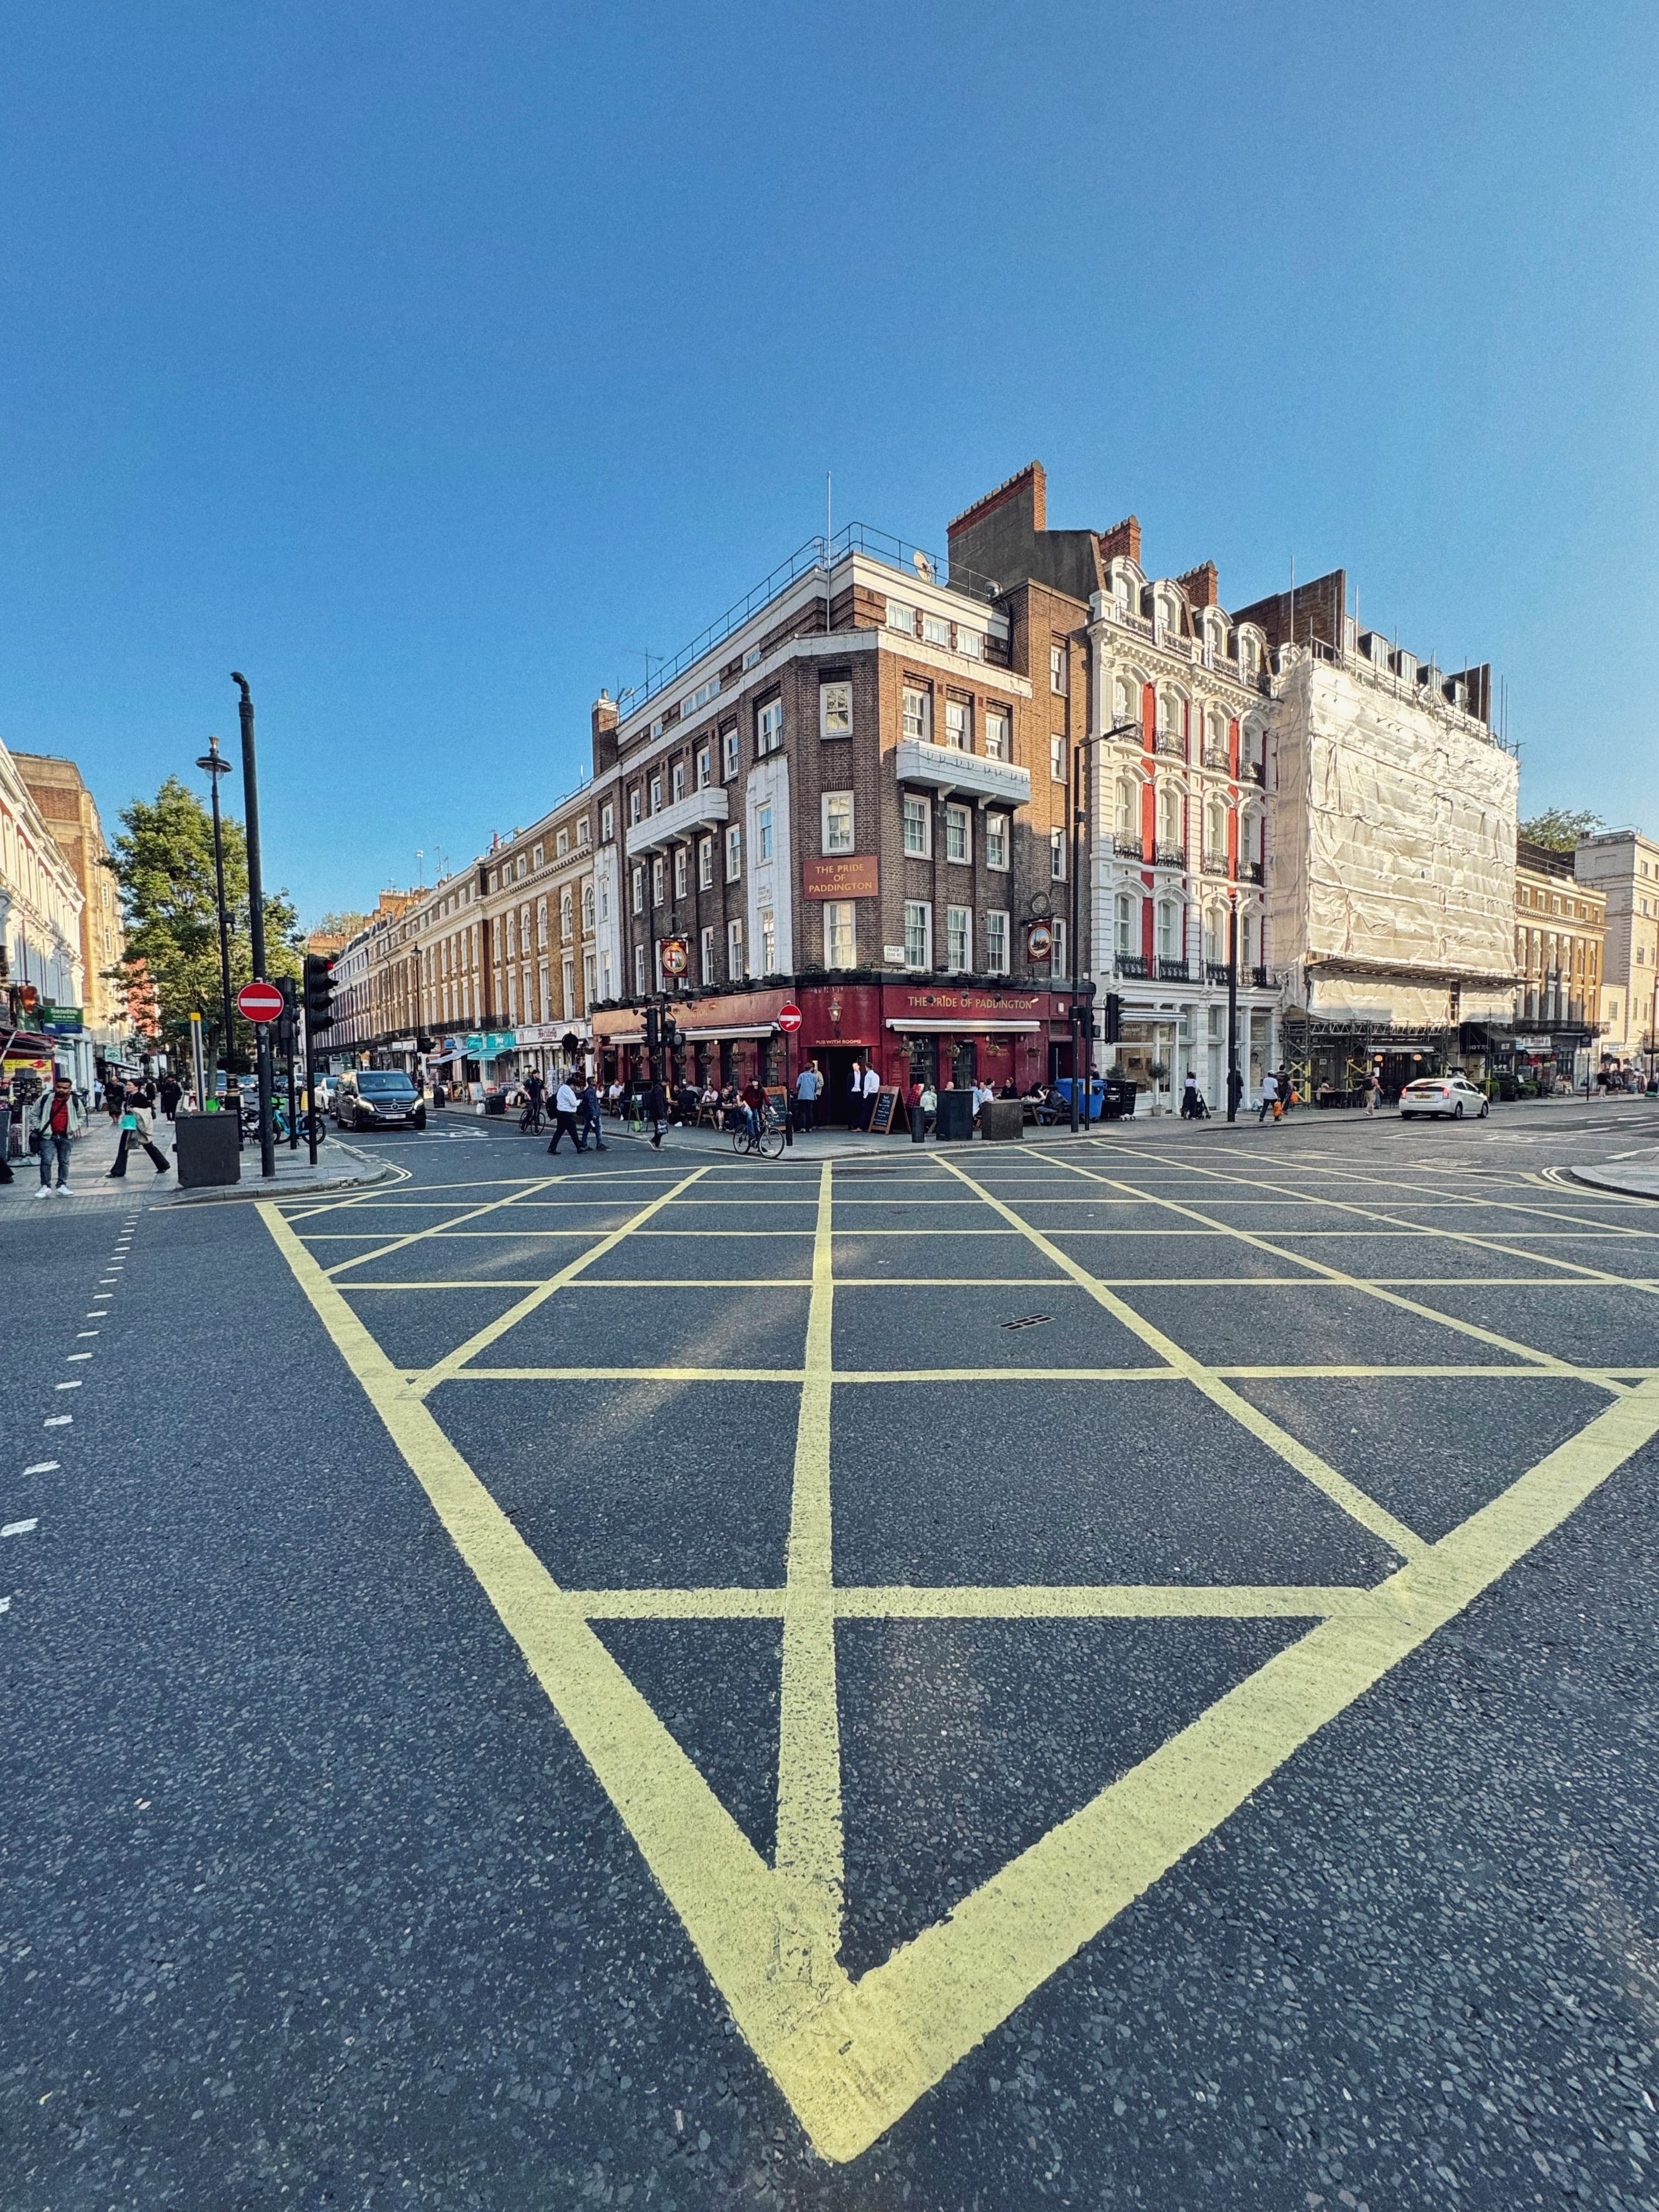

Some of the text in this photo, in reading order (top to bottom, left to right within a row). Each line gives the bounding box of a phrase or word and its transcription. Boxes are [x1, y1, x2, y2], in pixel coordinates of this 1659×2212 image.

[815, 864, 865, 874] THE PRIDE
[809, 882, 872, 892] PADDINGTON
[907, 996, 1032, 1009] THE PRIDE OF PADDINGTON
